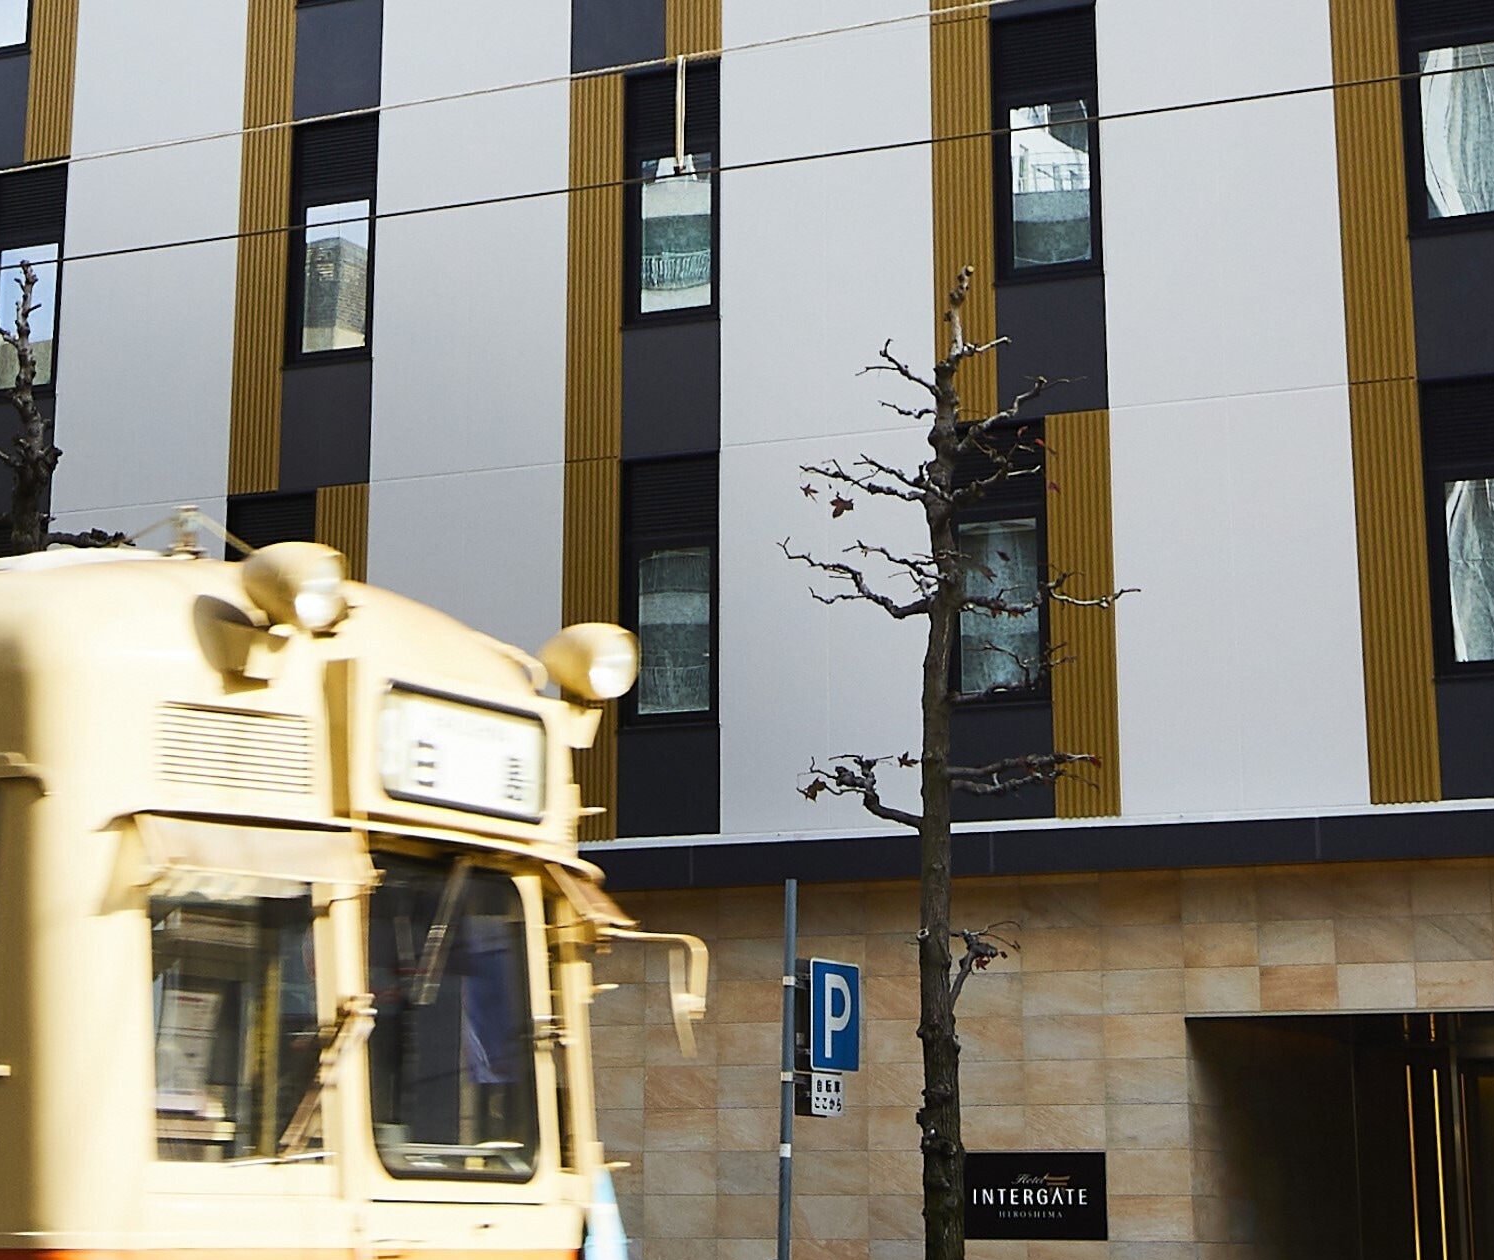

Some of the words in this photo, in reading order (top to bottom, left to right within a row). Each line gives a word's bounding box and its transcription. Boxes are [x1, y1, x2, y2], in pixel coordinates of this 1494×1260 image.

[823, 972, 852, 1059] P
[972, 1186, 1088, 1206] INTERGATE
[998, 1210, 1063, 1219] HIROSHIMA
